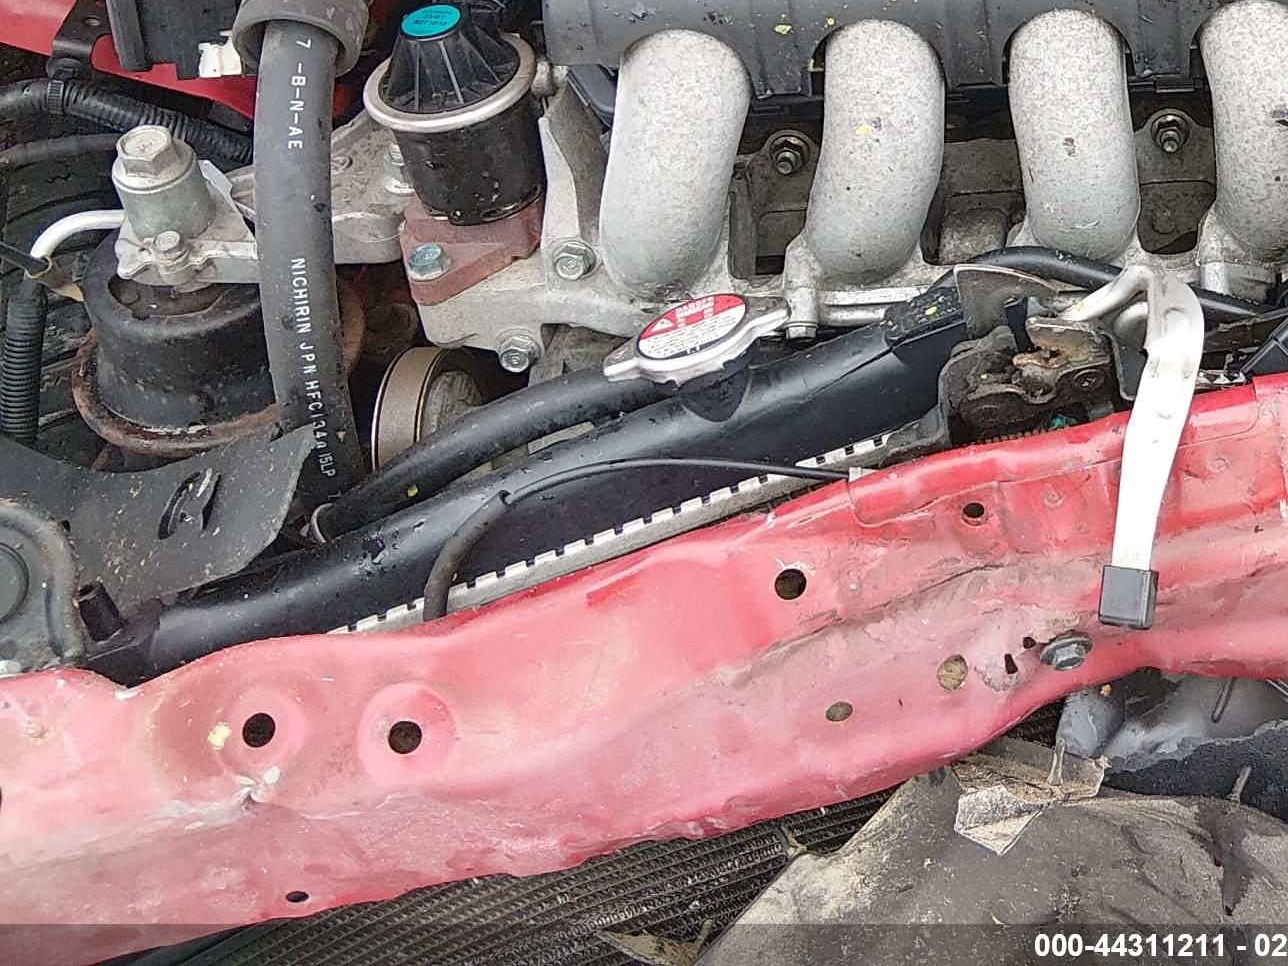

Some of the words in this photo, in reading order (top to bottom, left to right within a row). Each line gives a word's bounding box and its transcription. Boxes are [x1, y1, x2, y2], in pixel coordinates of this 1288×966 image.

[296, 38, 312, 50] 7
[290, 257, 313, 334] NICHIRIN
[299, 342, 317, 375] JPN
